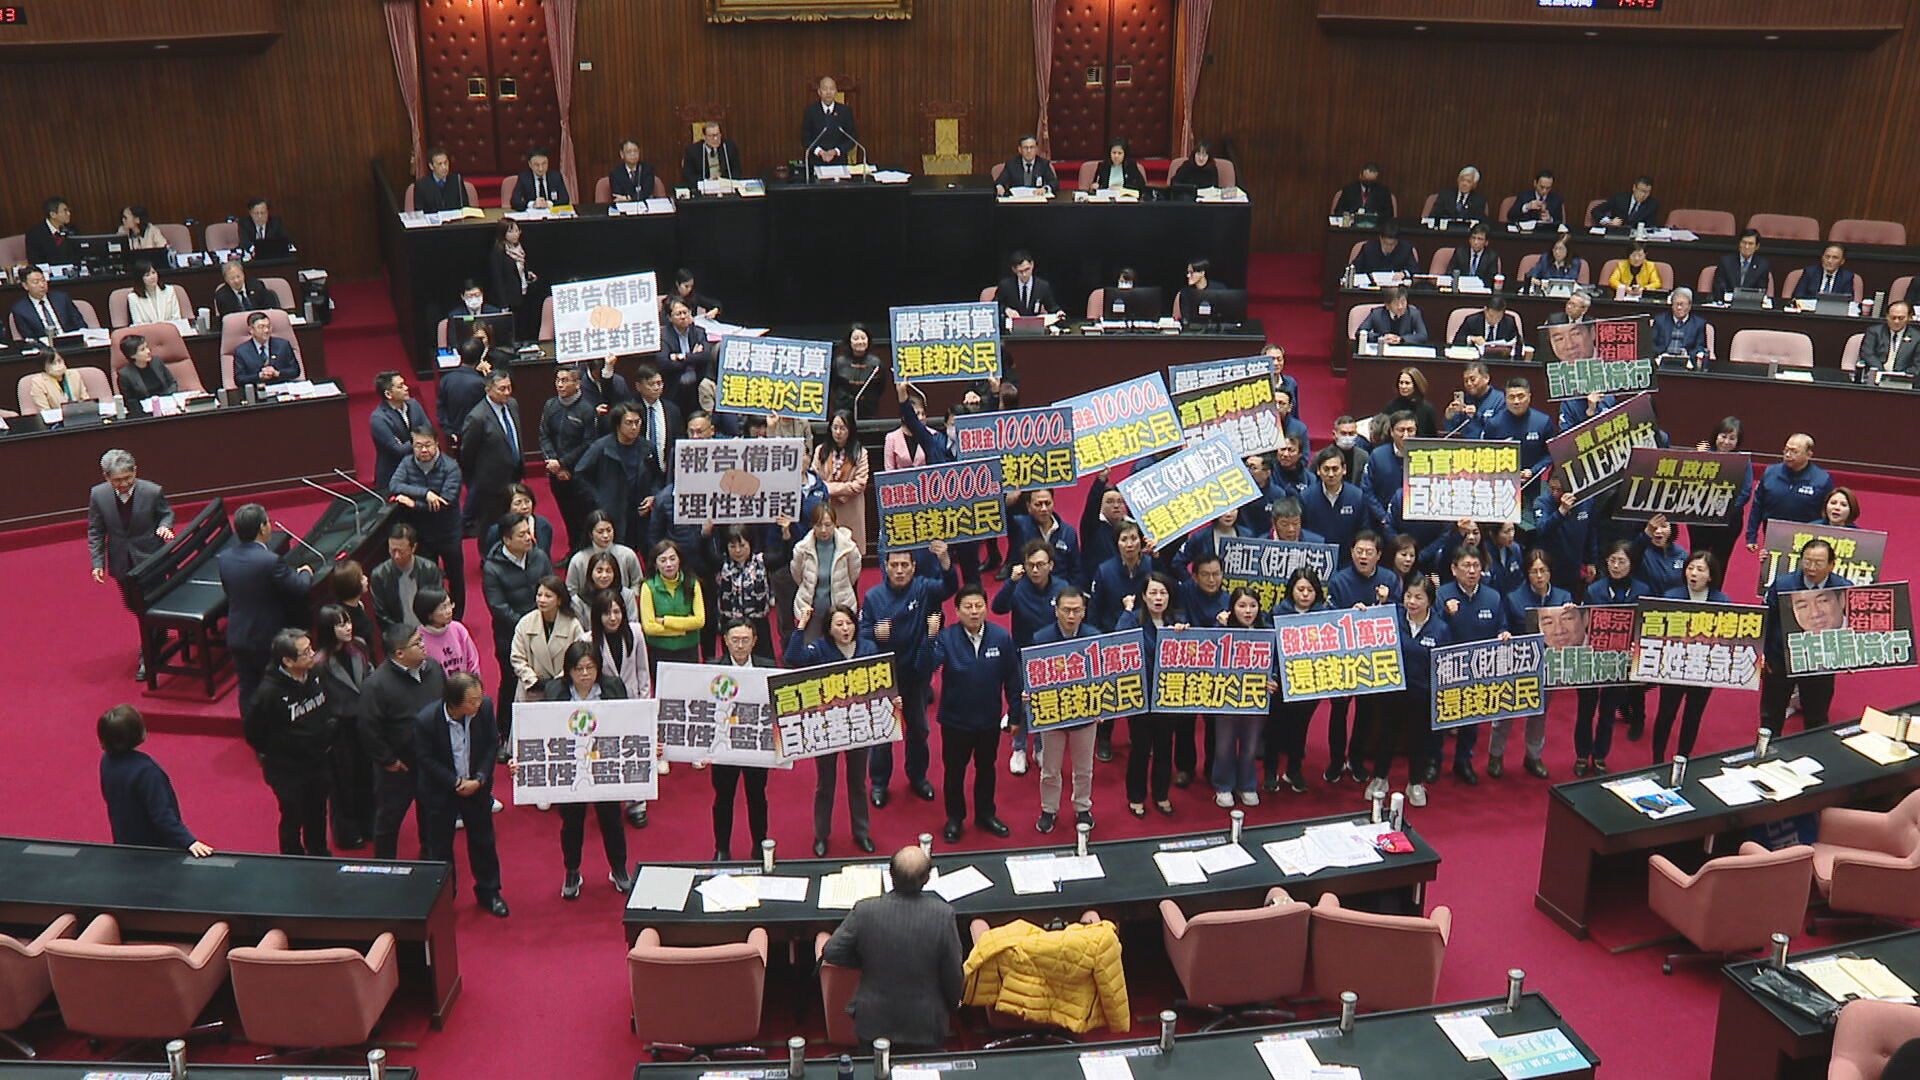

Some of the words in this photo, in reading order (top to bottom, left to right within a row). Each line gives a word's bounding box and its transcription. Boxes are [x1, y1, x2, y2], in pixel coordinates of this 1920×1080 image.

[556, 278, 652, 313] 報告備詢
[559, 319, 656, 355] 理性對話
[895, 306, 996, 342] 嚴審預算
[723, 340, 827, 377] 嚴審預算
[897, 341, 998, 377] 還錢於民
[1547, 358, 1652, 397] 詐騙橫行
[721, 374, 825, 415] 還錢於民
[1072, 381, 1169, 431] 現金10000元
[1178, 379, 1272, 428] 高官爽烤肉
[680, 445, 799, 473] 報告備詢
[1074, 411, 1180, 471] 還錢於民
[1408, 447, 1517, 475] 高官爽烤肉
[678, 491, 798, 520] 理性對話
[1141, 466, 1253, 543] 還錢於民
[1409, 477, 1517, 519] 百姓塞急診
[1622, 475, 1736, 517] LIE政府
[884, 500, 1002, 547] 還錢於民
[1850, 592, 1891, 611] 德宗
[1281, 613, 1397, 656] 發現金1萬元
[1642, 610, 1762, 639] 高官爽烤肉
[1026, 641, 1141, 687] 發現金1萬元
[1160, 633, 1271, 669] 發現金1萬元
[1436, 639, 1541, 685] 補正《財劃法》
[1638, 639, 1758, 685] 百姓塞急診
[1788, 629, 1912, 673] 詐騙橫行
[774, 661, 894, 716] 高官爽烤肉
[1157, 672, 1267, 709] 還錢於民
[1286, 649, 1401, 696] 還錢於民
[658, 699, 716, 722] 民生
[1031, 674, 1144, 727] 還錢於民
[1437, 676, 1541, 723] 還錢於民
[657, 723, 715, 747] 理性
[778, 696, 896, 758] 百姓塞急診
[518, 738, 577, 762] 民生
[592, 735, 651, 760] 優先
[517, 762, 577, 787] 理性
[592, 759, 651, 785] 監督
